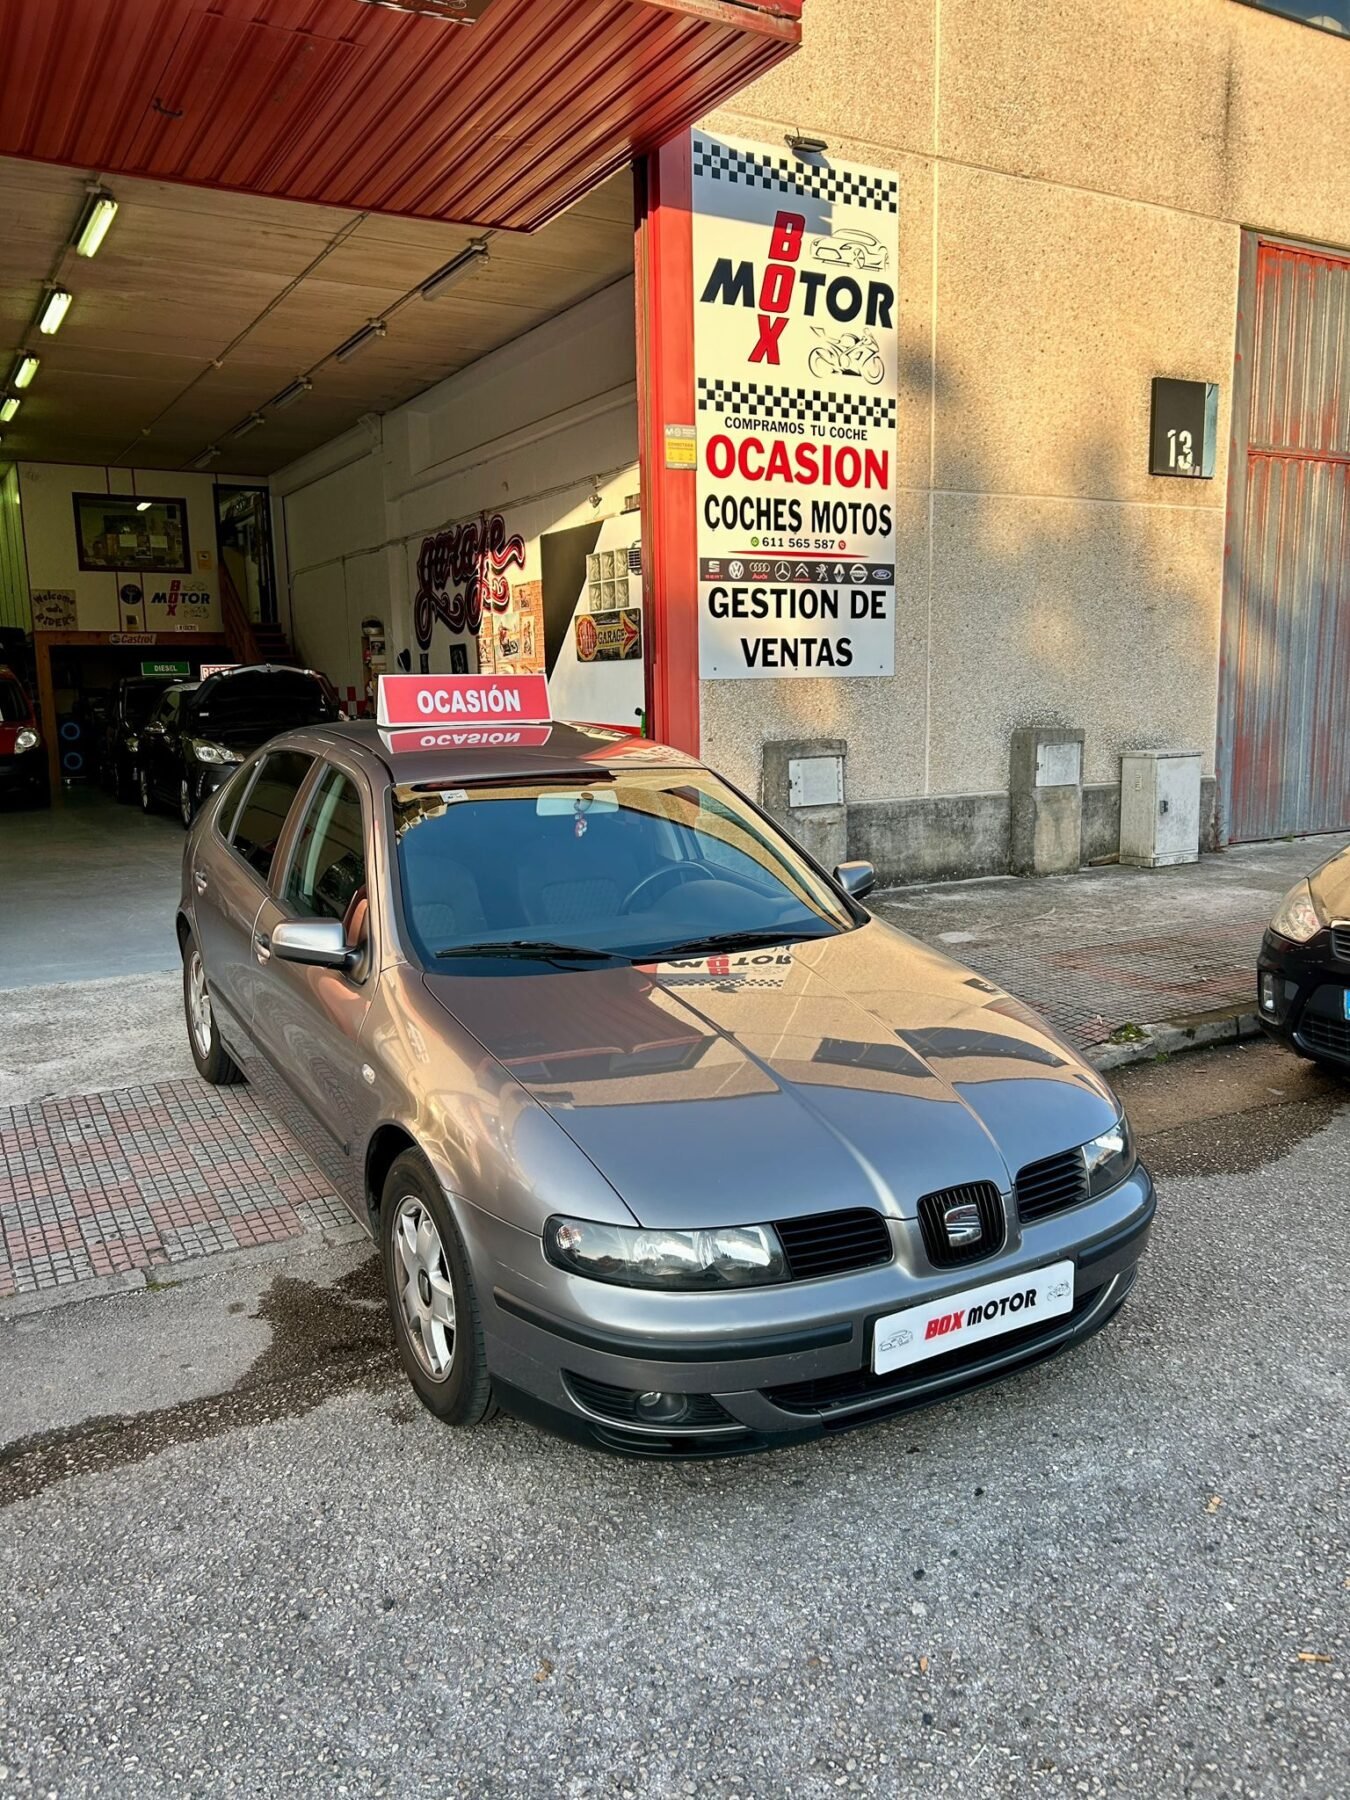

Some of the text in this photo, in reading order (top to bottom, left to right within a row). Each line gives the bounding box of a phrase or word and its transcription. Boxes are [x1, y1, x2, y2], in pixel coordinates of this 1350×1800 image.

[700, 257, 895, 329] MOTOR
[747, 210, 806, 366] BOX
[724, 416, 868, 441] COMPRAMOS TU COCHE
[705, 434, 889, 490] OCASION
[1167, 429, 1193, 470] 13
[704, 494, 892, 537] COCHES MOTOS
[762, 537, 835, 550] 611 565 587
[752, 573, 768, 581] Audi
[151, 592, 210, 605] MOTOR
[167, 580, 181, 616] BOX
[708, 587, 887, 620] GESTION DE
[121, 634, 153, 644] Castrol
[598, 628, 625, 645] GARAGE
[741, 637, 853, 668] VENTAS
[417, 684, 521, 714] OCASIÓN
[924, 1288, 1037, 1340] BOX MOTOR
